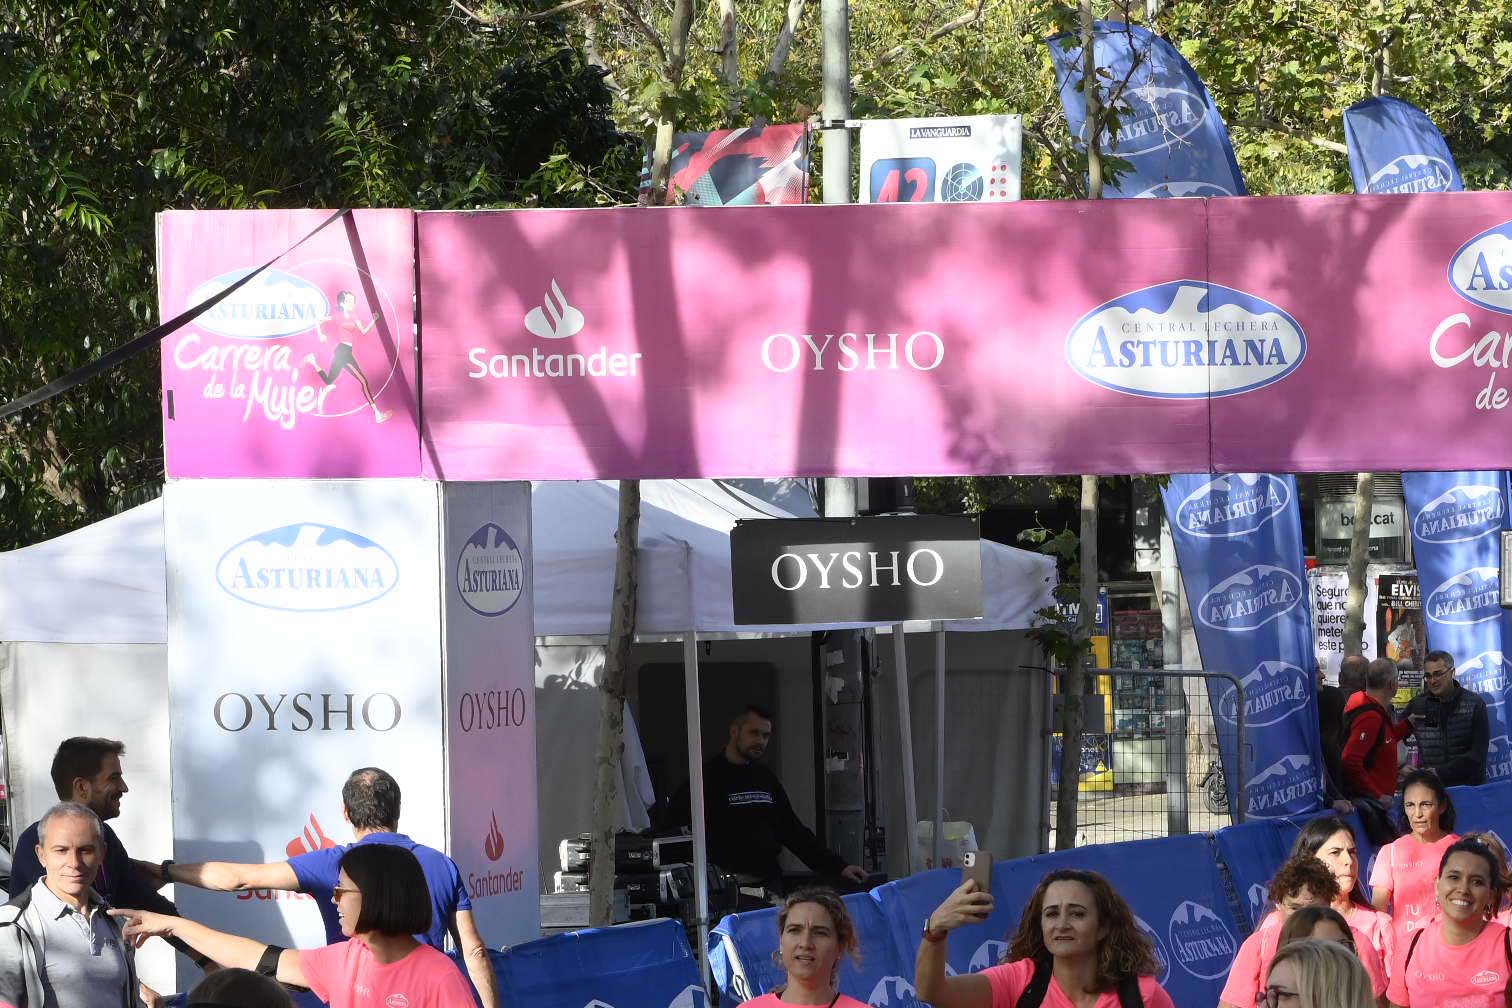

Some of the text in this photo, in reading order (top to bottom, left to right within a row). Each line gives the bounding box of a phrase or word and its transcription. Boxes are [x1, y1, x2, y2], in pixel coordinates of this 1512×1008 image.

[1121, 320, 1280, 334] CENTRAL LECHERA
[174, 334, 292, 371] Carrera
[469, 347, 642, 379] Santander
[761, 331, 945, 373] OYSHO
[1086, 325, 1288, 369] ASTURIANA
[203, 367, 336, 430] de la Mujer
[1475, 372, 1509, 411] de
[230, 556, 386, 590] ASTURIANA
[462, 556, 521, 595] ASTURIANA
[771, 548, 945, 591] OYSHO
[1319, 640, 1338, 651] este
[213, 692, 402, 733] OYSHO
[459, 687, 526, 733] OYSHO
[468, 867, 524, 899] Santander
